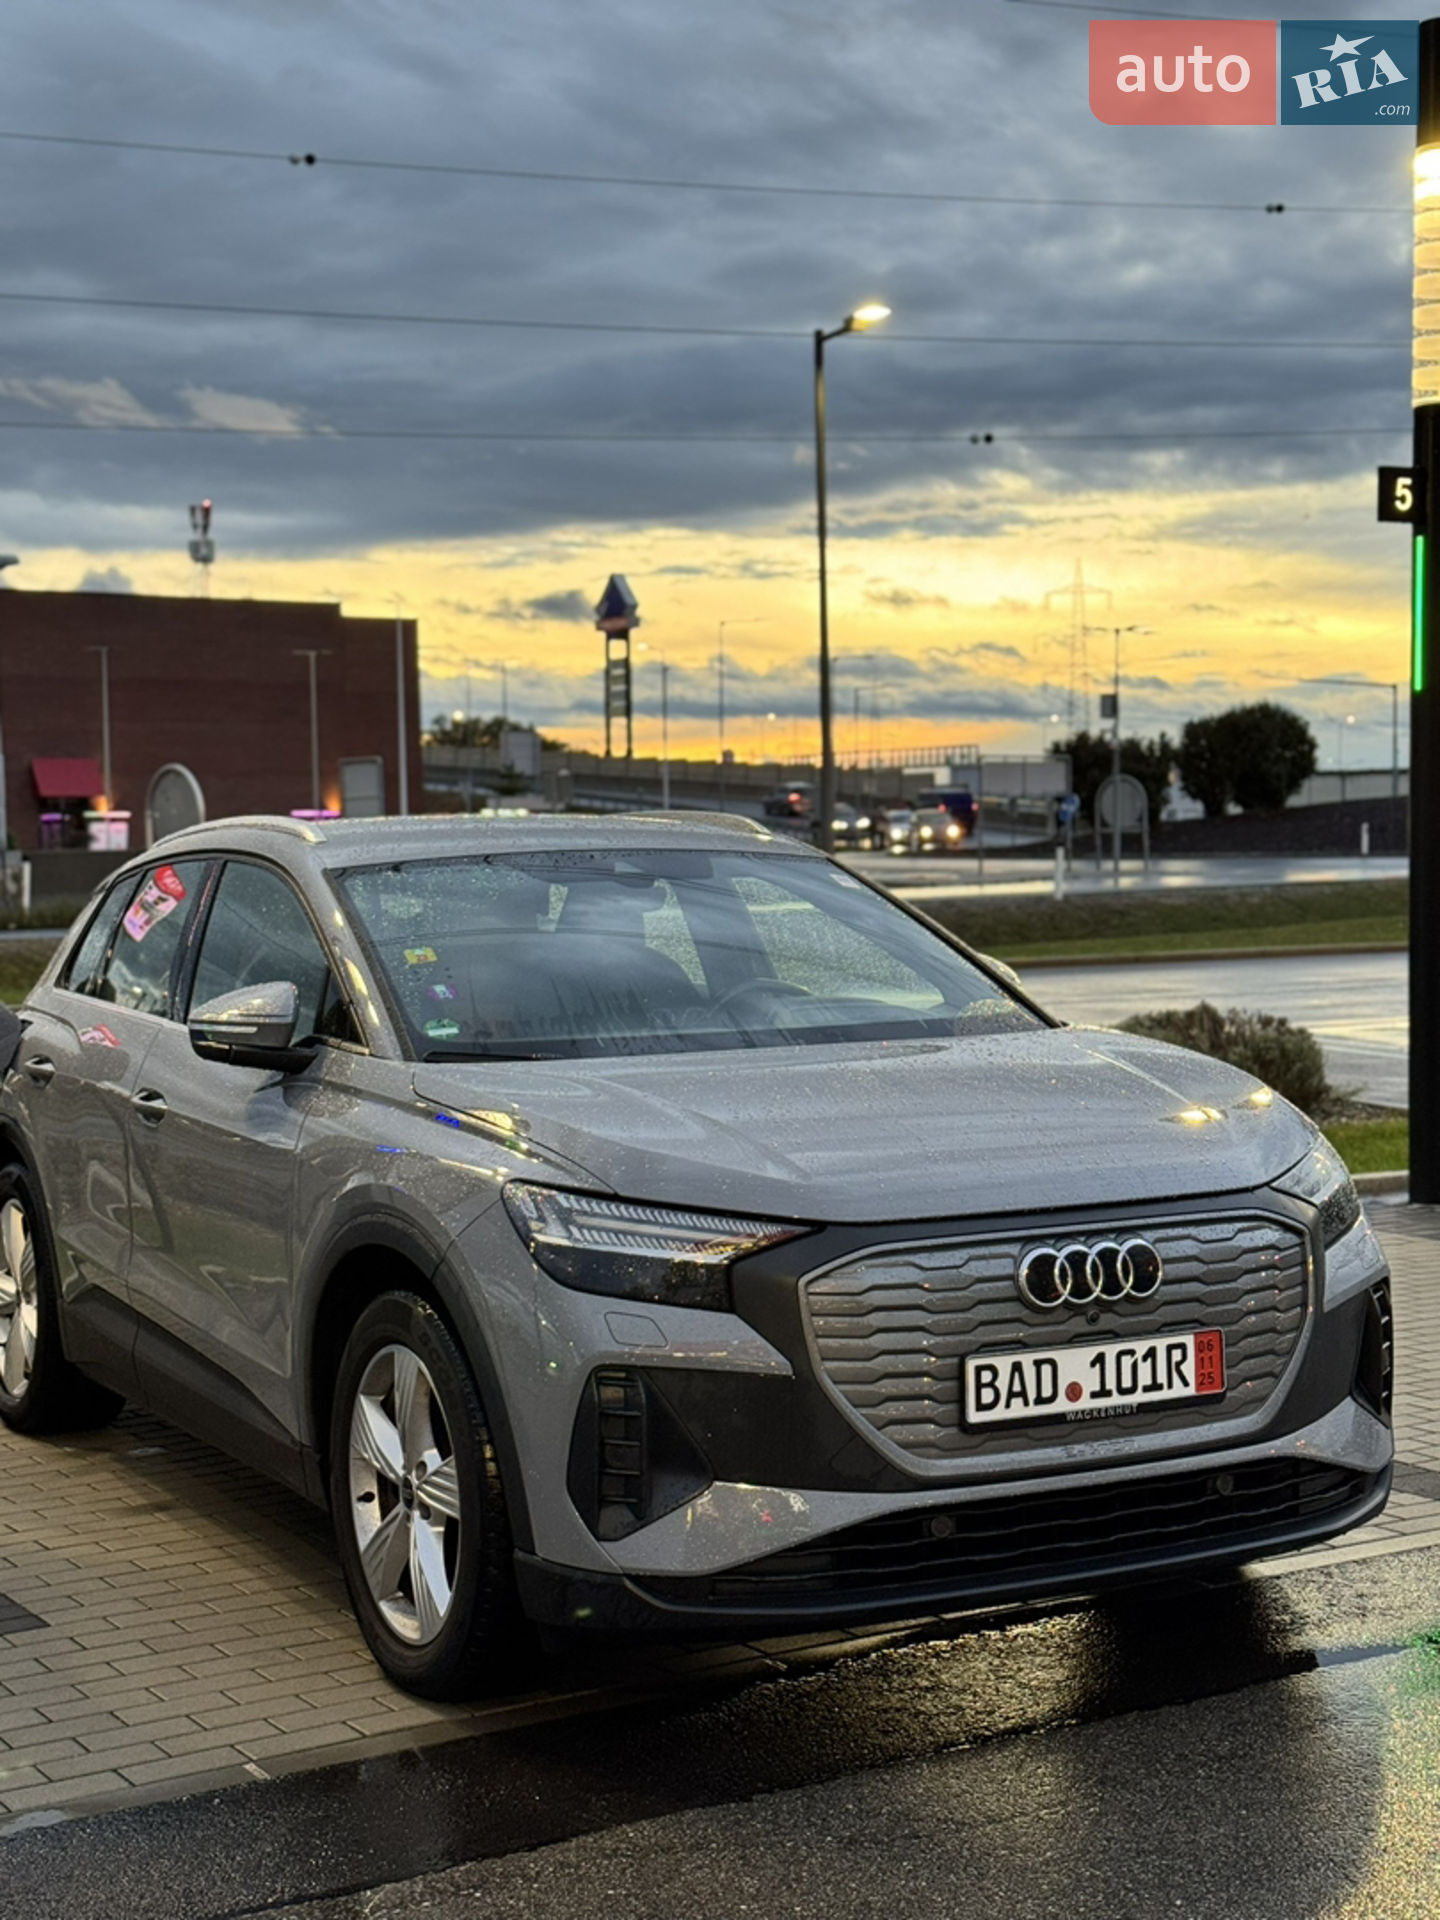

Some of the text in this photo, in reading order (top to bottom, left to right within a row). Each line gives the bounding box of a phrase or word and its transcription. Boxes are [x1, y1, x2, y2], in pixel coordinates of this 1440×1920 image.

[1394, 476, 1413, 511] 5
[1198, 1338, 1214, 1353] 06
[1199, 1356, 1213, 1369] 11
[974, 1342, 1190, 1412] BAD 101R
[1198, 1371, 1215, 1386] 25
[1065, 1403, 1139, 1421] WACKENHUT
